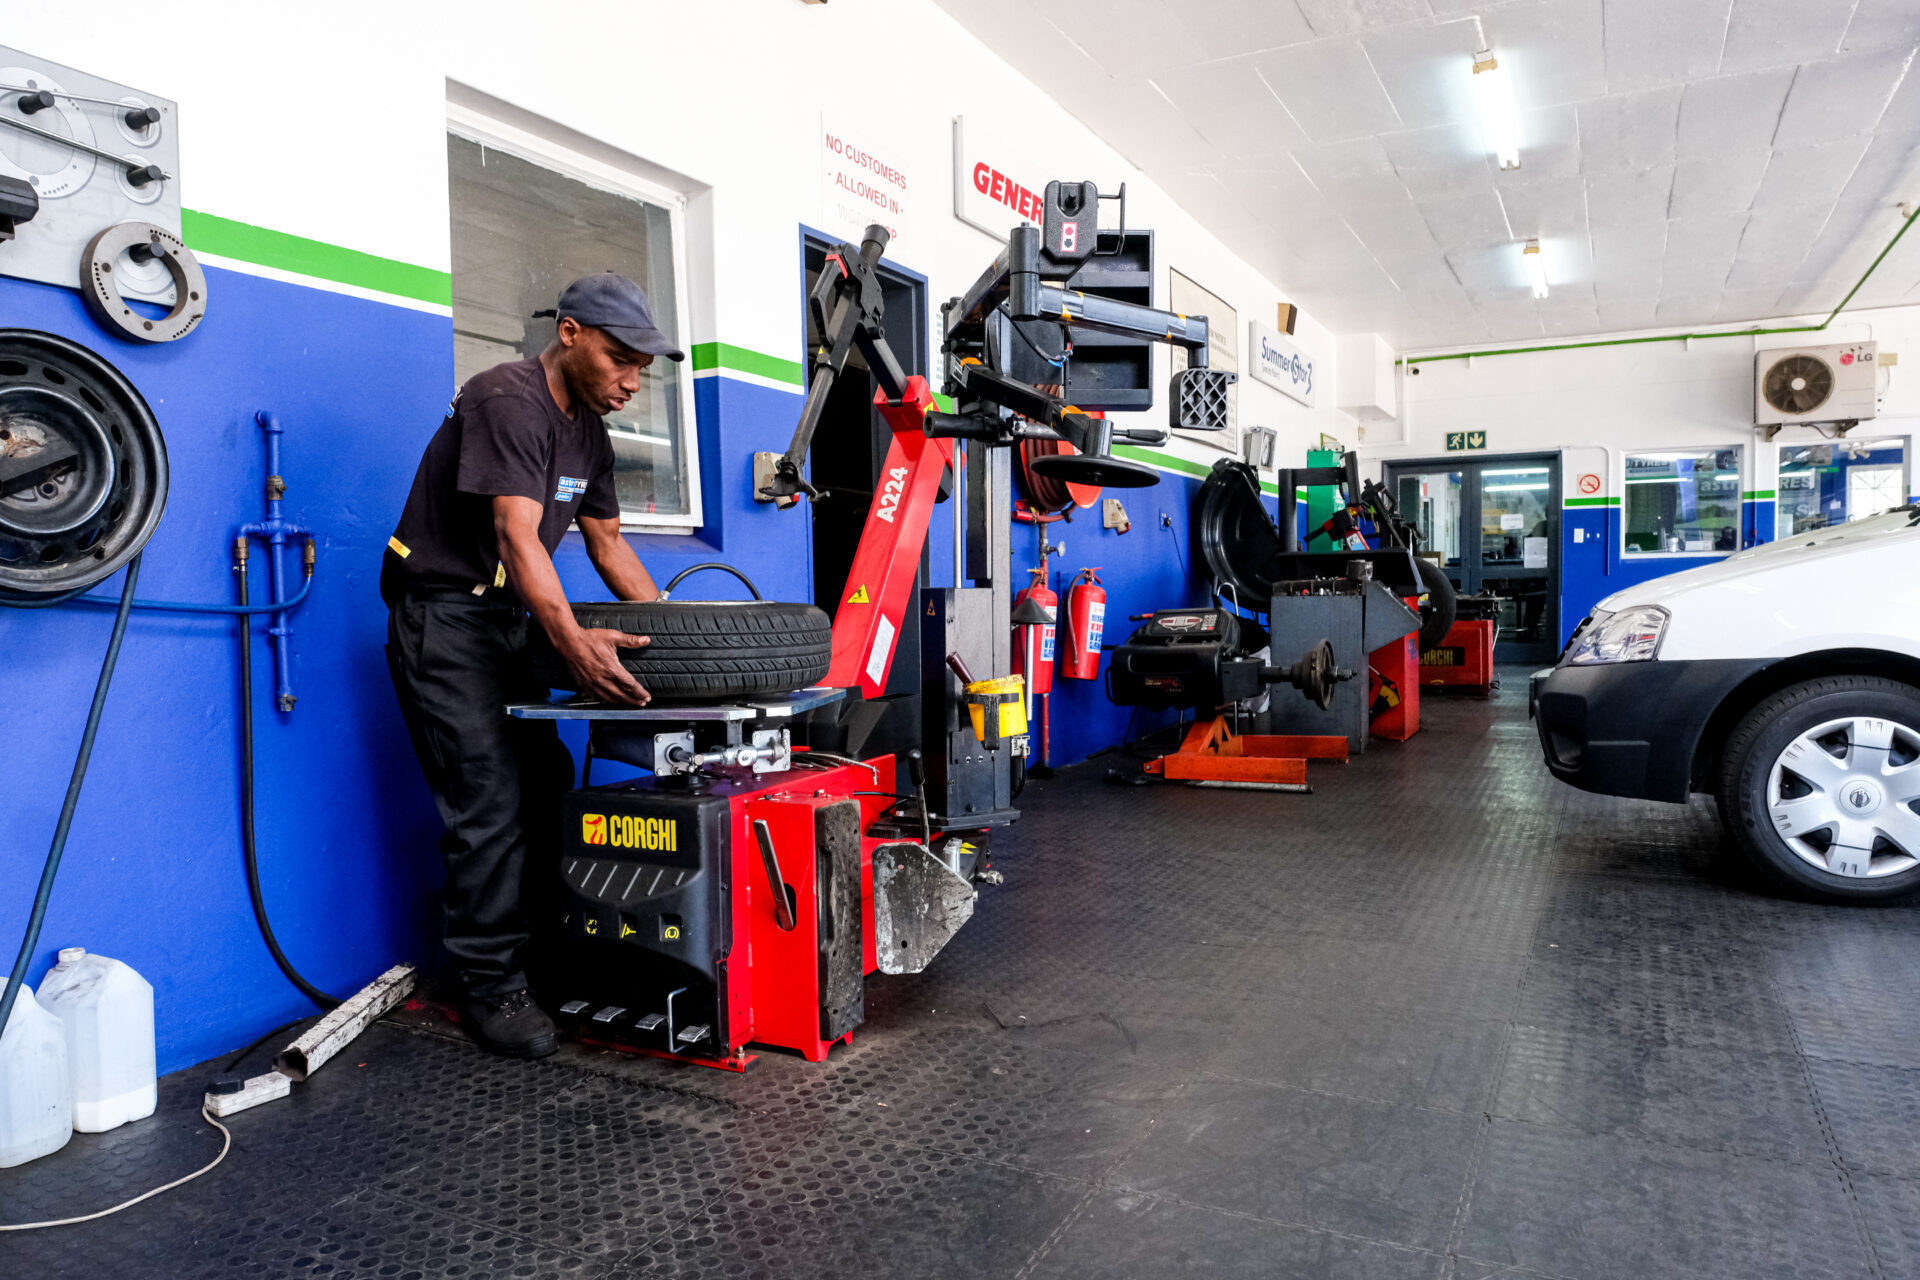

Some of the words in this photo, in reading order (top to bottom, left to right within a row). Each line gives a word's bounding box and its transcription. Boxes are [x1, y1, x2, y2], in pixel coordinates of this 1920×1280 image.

[826, 133, 842, 154] NO
[845, 144, 906, 190] CUSTOMERS
[836, 171, 887, 208] ALLOWED
[889, 197, 899, 215] IN
[837, 201, 897, 242] WORKP
[1857, 353, 1873, 362] LG
[876, 467, 908, 523] A224
[610, 814, 677, 852] CORGHI
